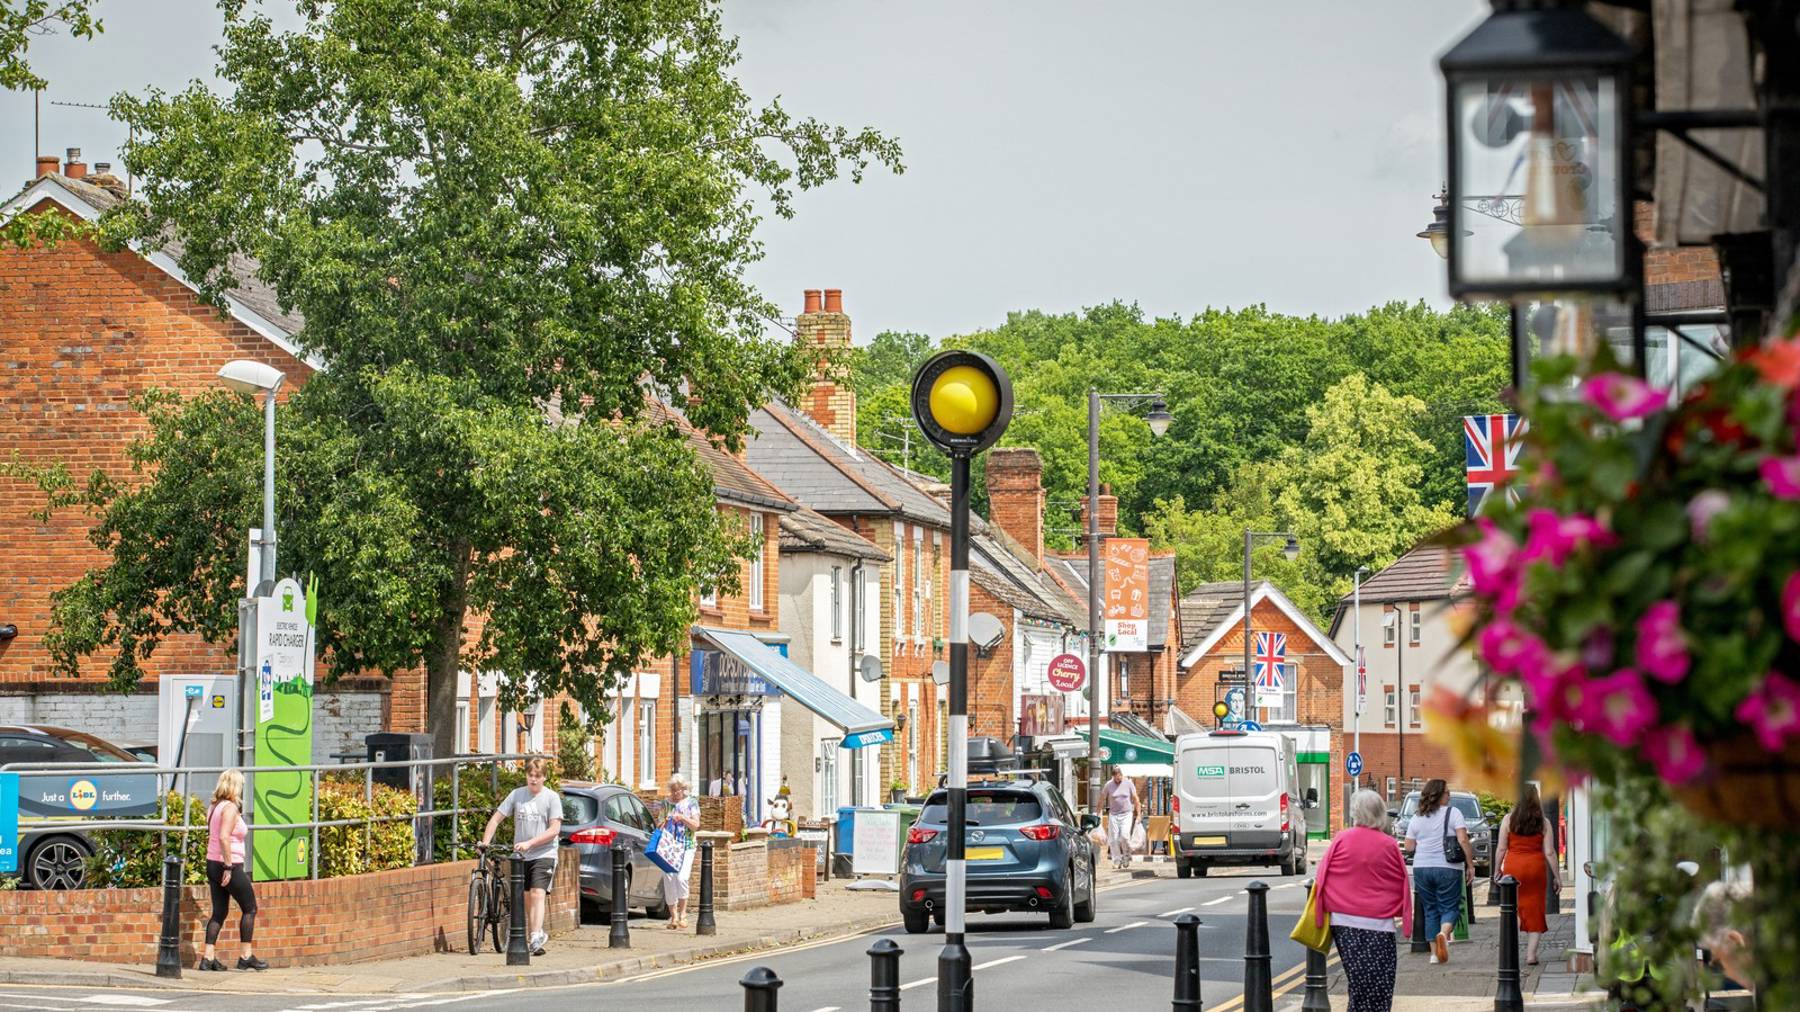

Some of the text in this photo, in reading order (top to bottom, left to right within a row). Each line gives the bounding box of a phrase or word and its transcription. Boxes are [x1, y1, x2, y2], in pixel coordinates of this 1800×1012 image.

[269, 632, 304, 648] RAPID CHARGER
[1052, 667, 1081, 682] Cherry
[1056, 680, 1074, 688] Local
[1198, 767, 1224, 775] MSA
[41, 791, 57, 802] Just
[58, 794, 65, 802] a
[102, 790, 131, 801] further.
